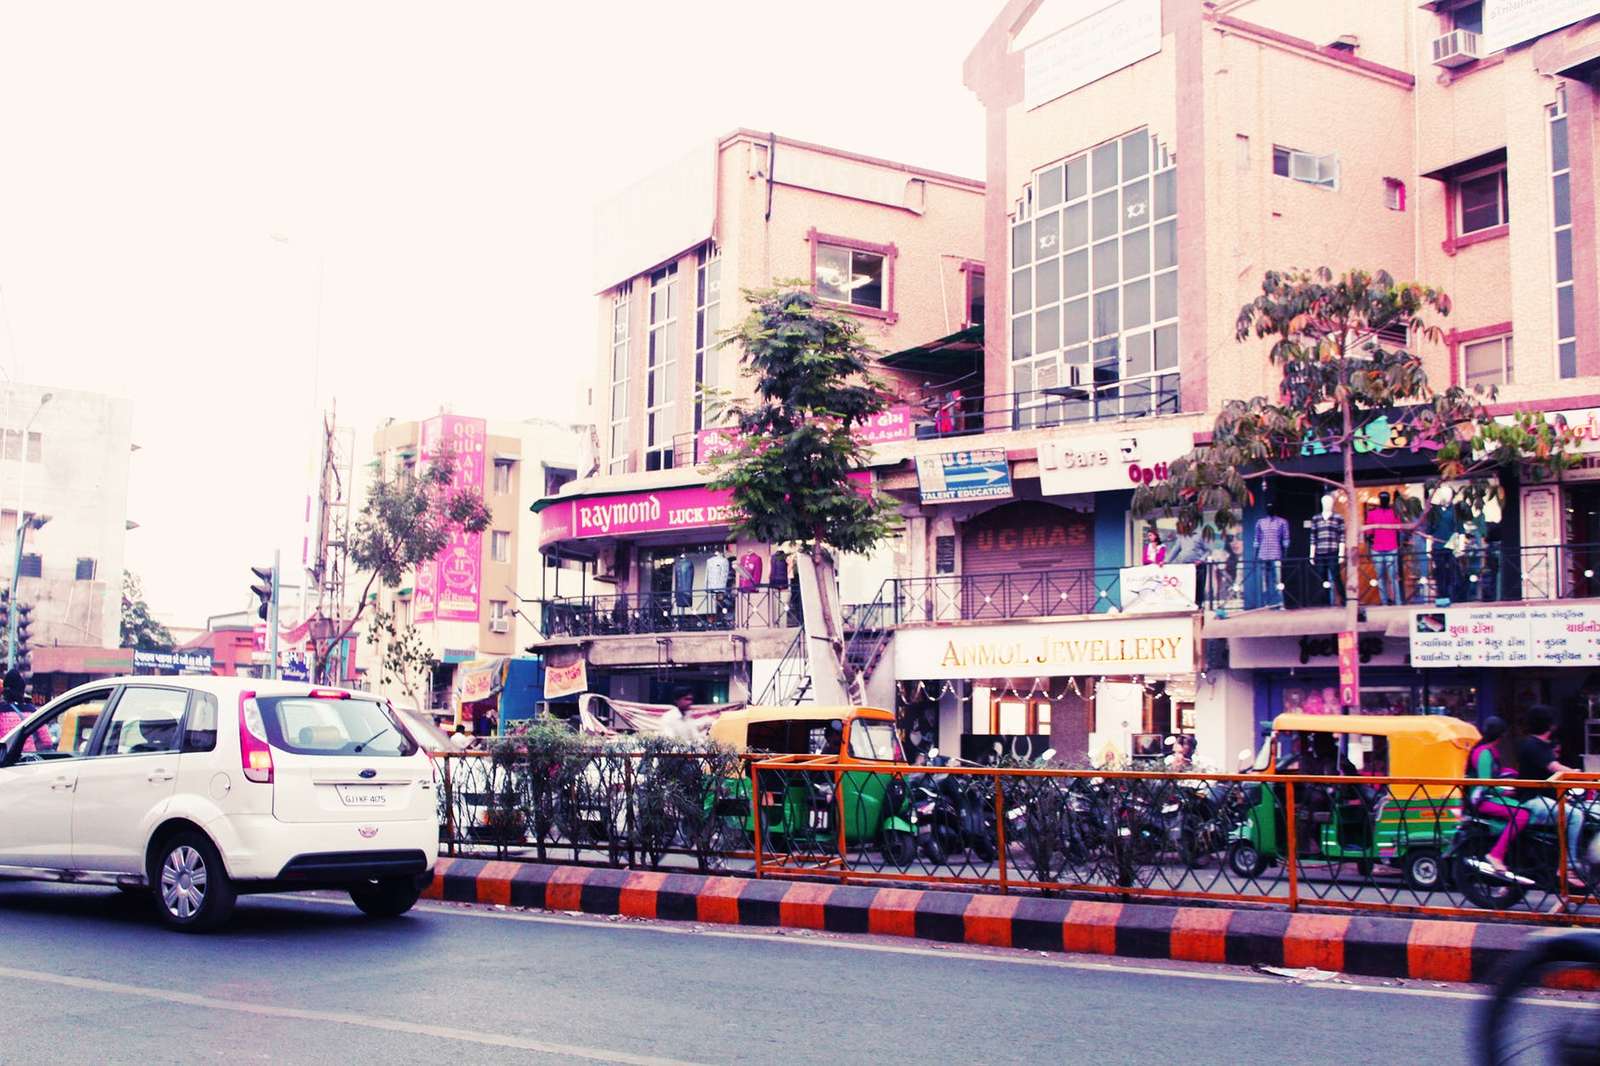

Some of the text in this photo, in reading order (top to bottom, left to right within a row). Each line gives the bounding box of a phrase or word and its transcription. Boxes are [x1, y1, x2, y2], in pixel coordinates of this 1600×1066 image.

[1063, 448, 1109, 469] Care
[1128, 461, 1168, 485] Opti
[450, 423, 463, 545] QUALY
[461, 423, 475, 545] QUANTY
[921, 491, 956, 501] TALENT
[957, 486, 1011, 498] EDUCATION
[580, 495, 661, 532] Raymond
[668, 508, 705, 525] LUCK
[941, 635, 1185, 666] ANMOL JEWELLERY
